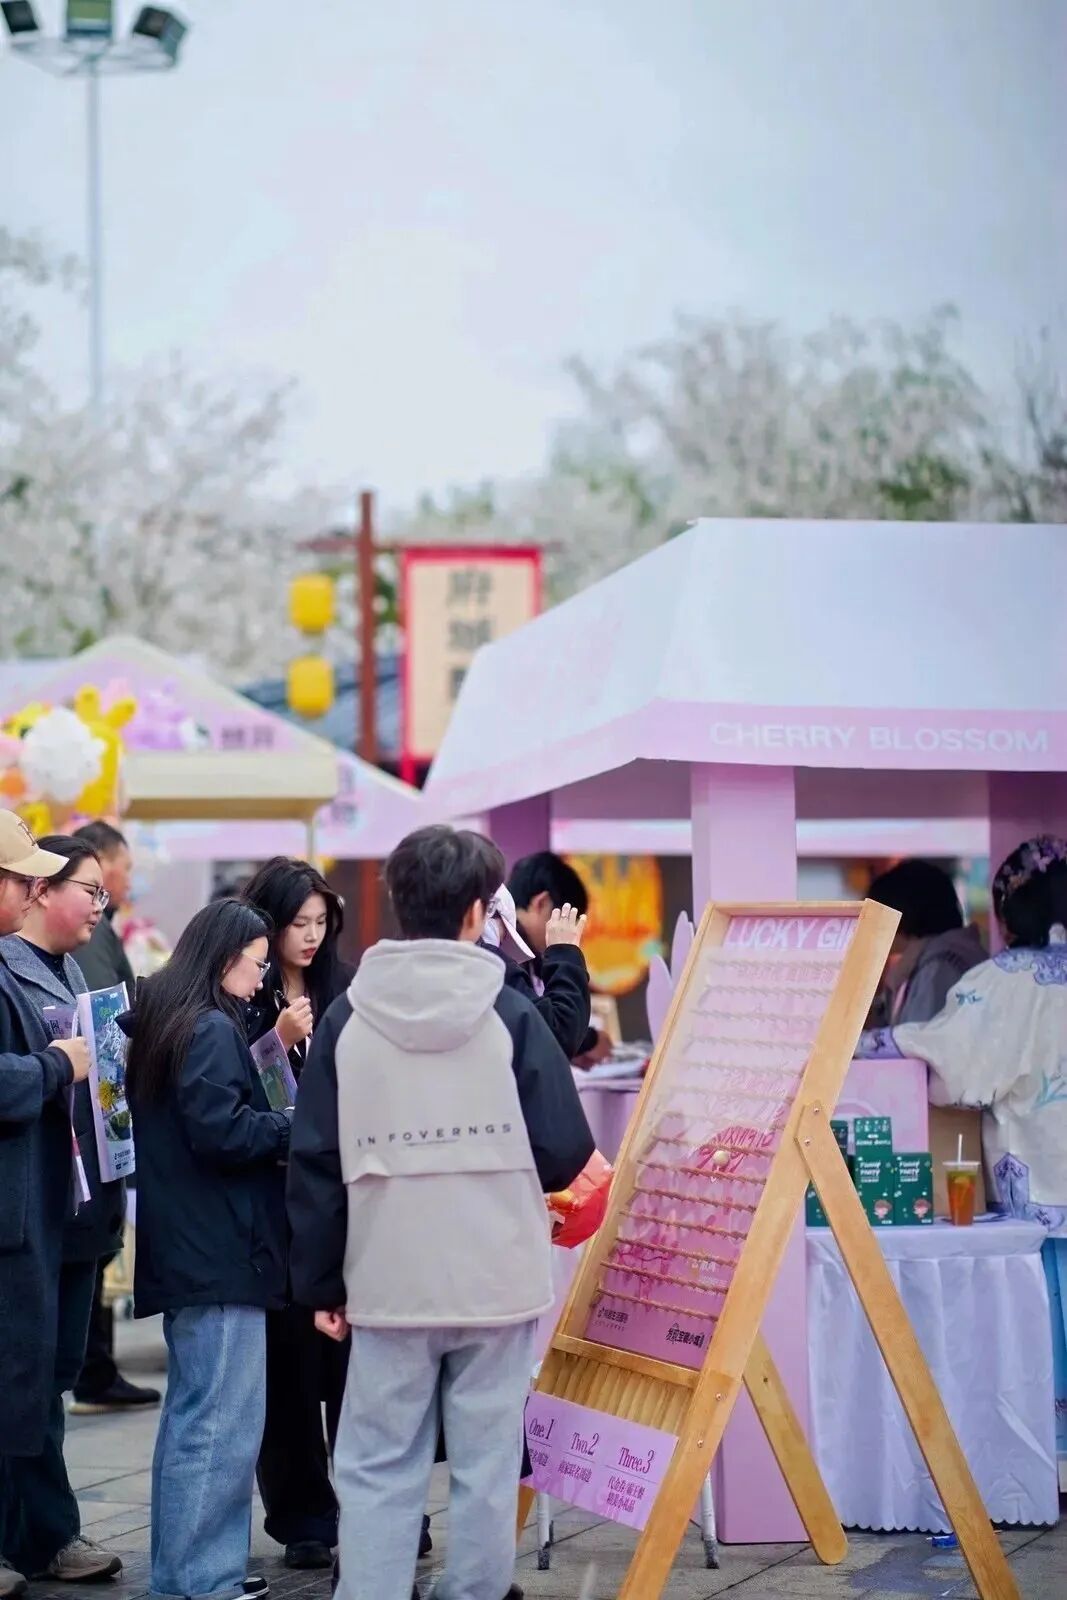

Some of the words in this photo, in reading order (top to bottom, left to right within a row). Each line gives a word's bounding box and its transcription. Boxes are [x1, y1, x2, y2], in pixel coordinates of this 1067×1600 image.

[709, 721, 856, 748] CHERRY
[869, 726, 1050, 752] BLOSSOM
[722, 918, 819, 950] LUCKY
[528, 1418, 555, 1440] One.1
[570, 1432, 600, 1455] Two.2
[617, 1447, 655, 1474] Three.3
